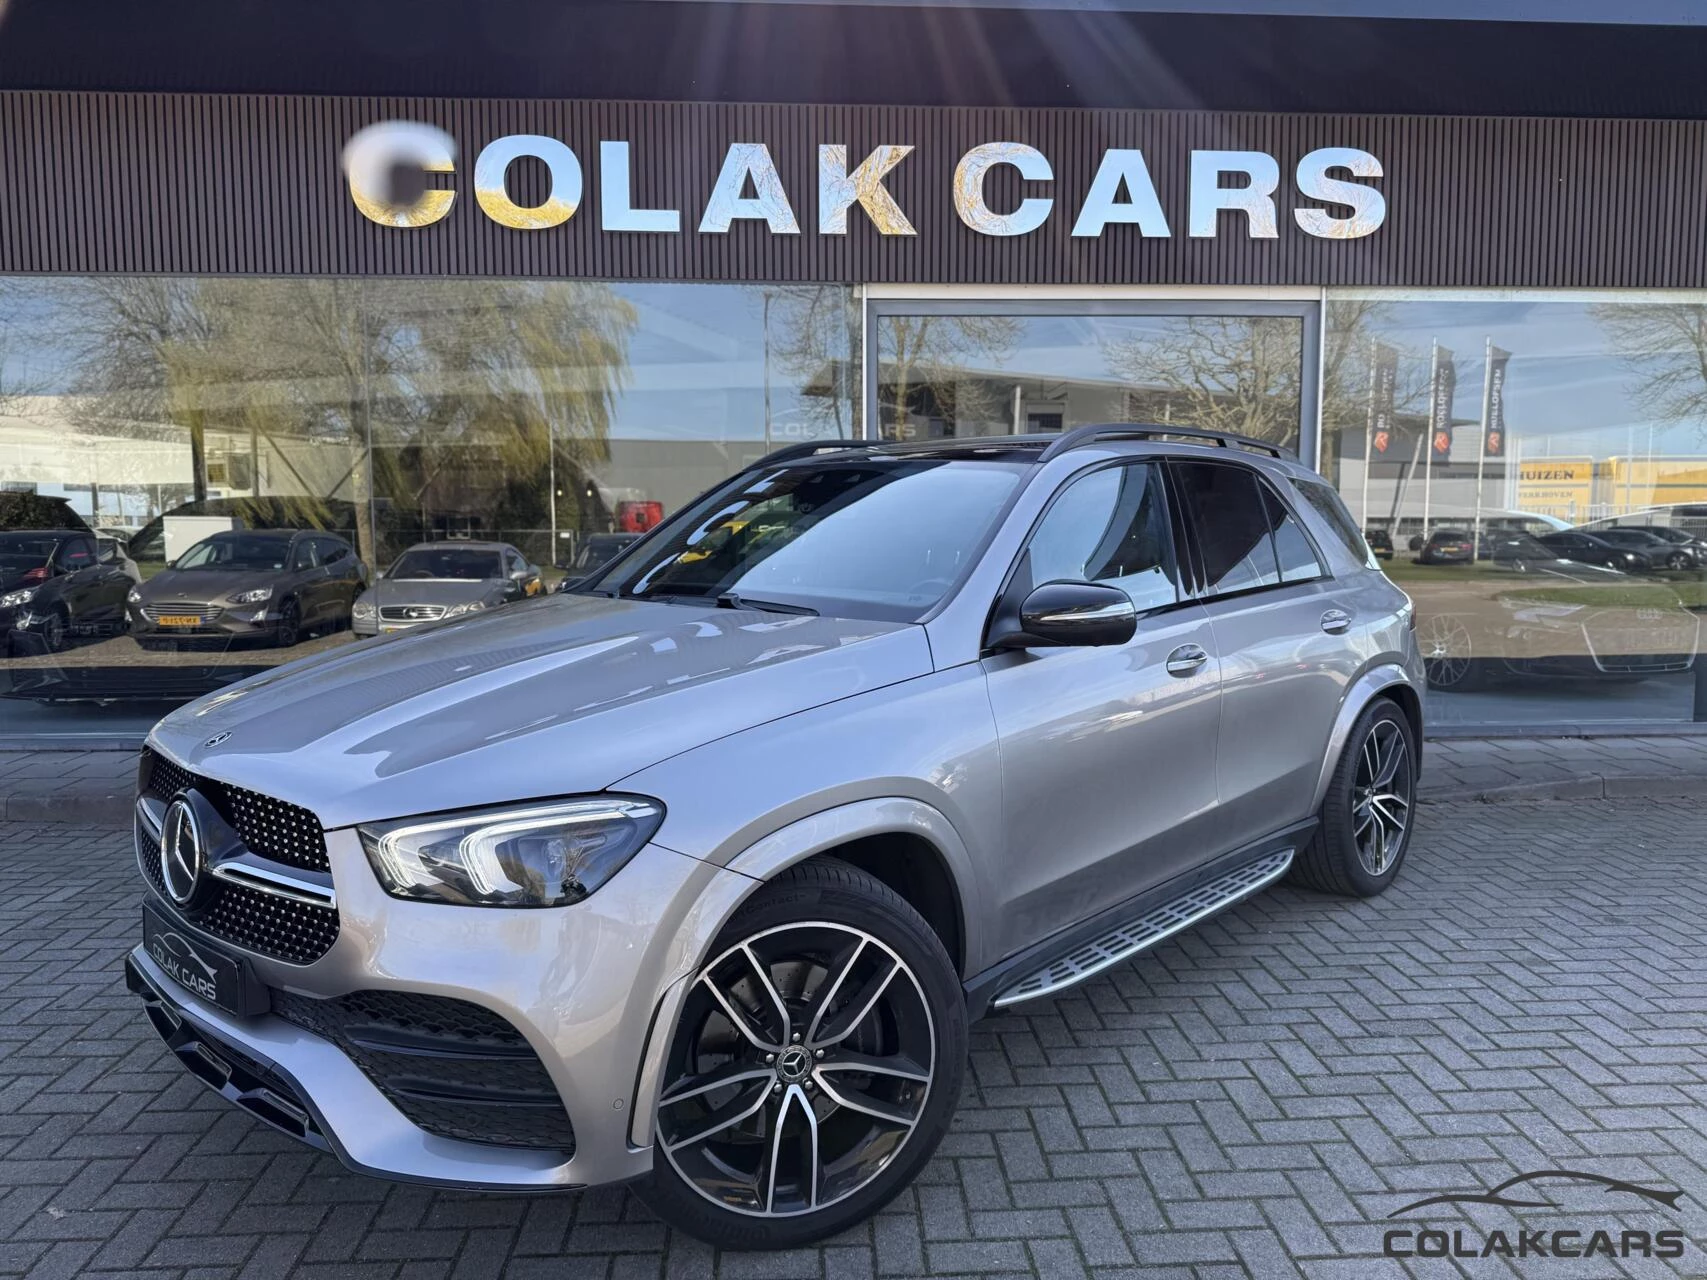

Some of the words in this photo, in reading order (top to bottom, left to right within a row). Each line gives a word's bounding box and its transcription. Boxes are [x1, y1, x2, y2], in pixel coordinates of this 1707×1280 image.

[346, 122, 917, 237] COLAK
[953, 141, 1386, 239] CARS
[152, 943, 180, 979] COLAK
[181, 968, 216, 1000] CARS
